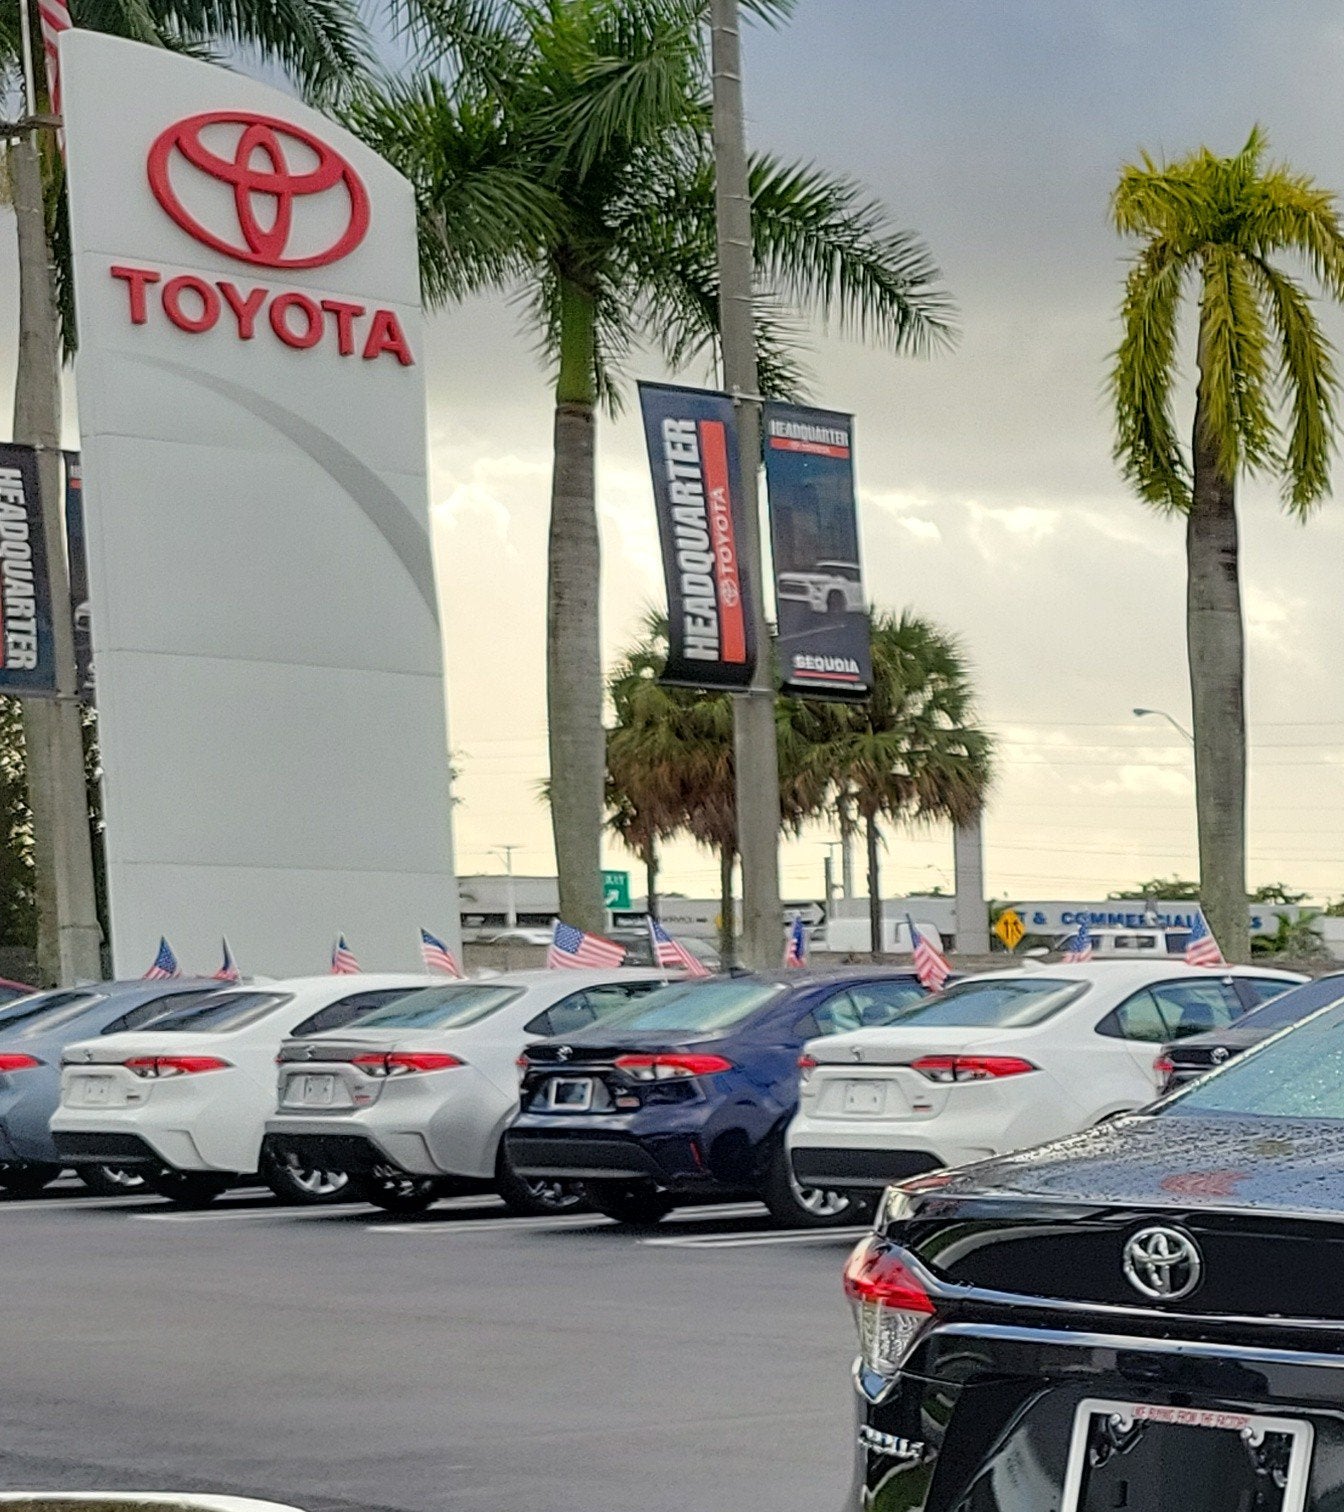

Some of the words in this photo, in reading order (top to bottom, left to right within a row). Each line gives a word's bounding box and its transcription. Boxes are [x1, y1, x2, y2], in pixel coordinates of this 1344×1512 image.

[110, 265, 415, 366] TOYOTA
[769, 419, 849, 448] HEADQUARTER
[0, 468, 38, 671] HEADQUARTER
[663, 418, 719, 661] HEADQUARTER
[709, 486, 736, 575] TOYOTA
[794, 653, 860, 674] SEQUOIA
